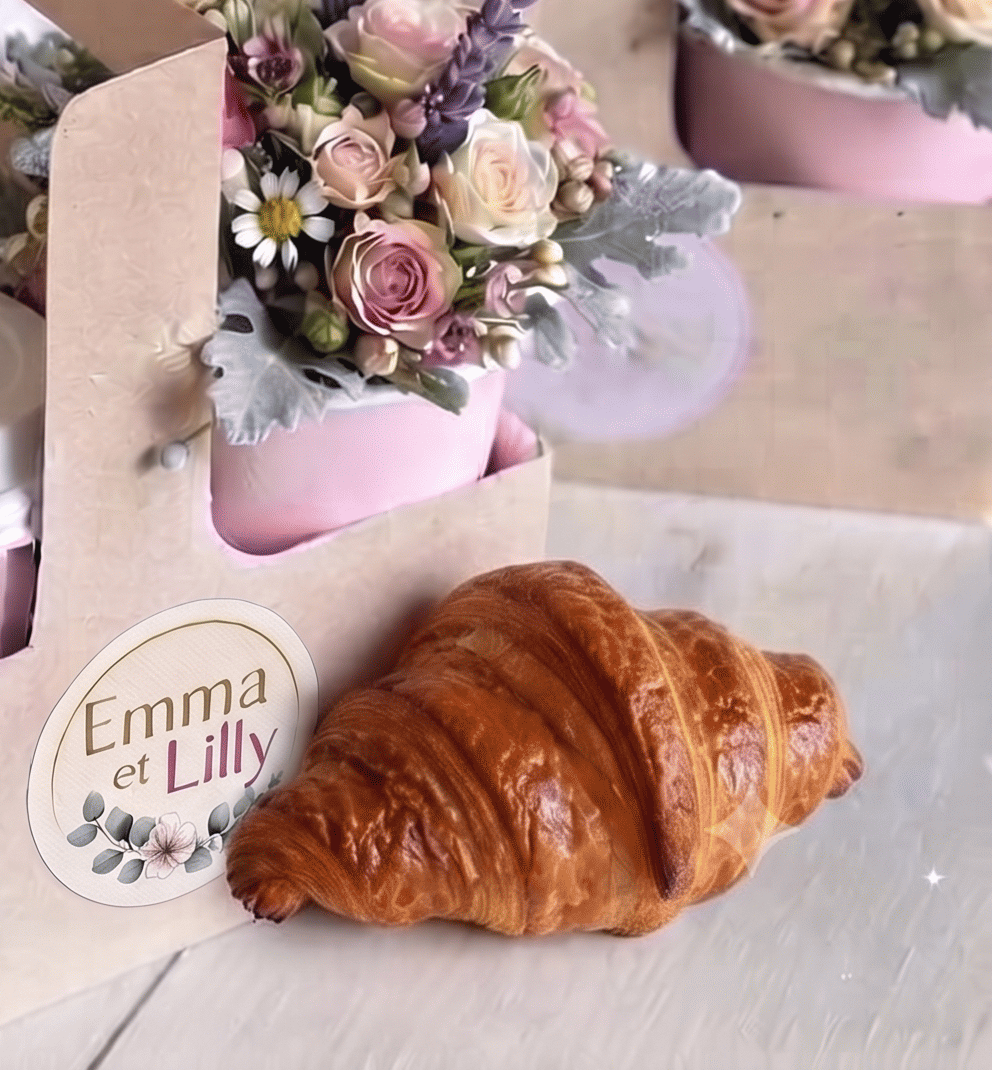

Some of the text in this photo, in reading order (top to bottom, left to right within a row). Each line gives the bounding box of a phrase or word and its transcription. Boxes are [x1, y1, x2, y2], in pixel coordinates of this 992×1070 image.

[85, 668, 267, 757] Emma
[113, 718, 279, 794] et Lilly
